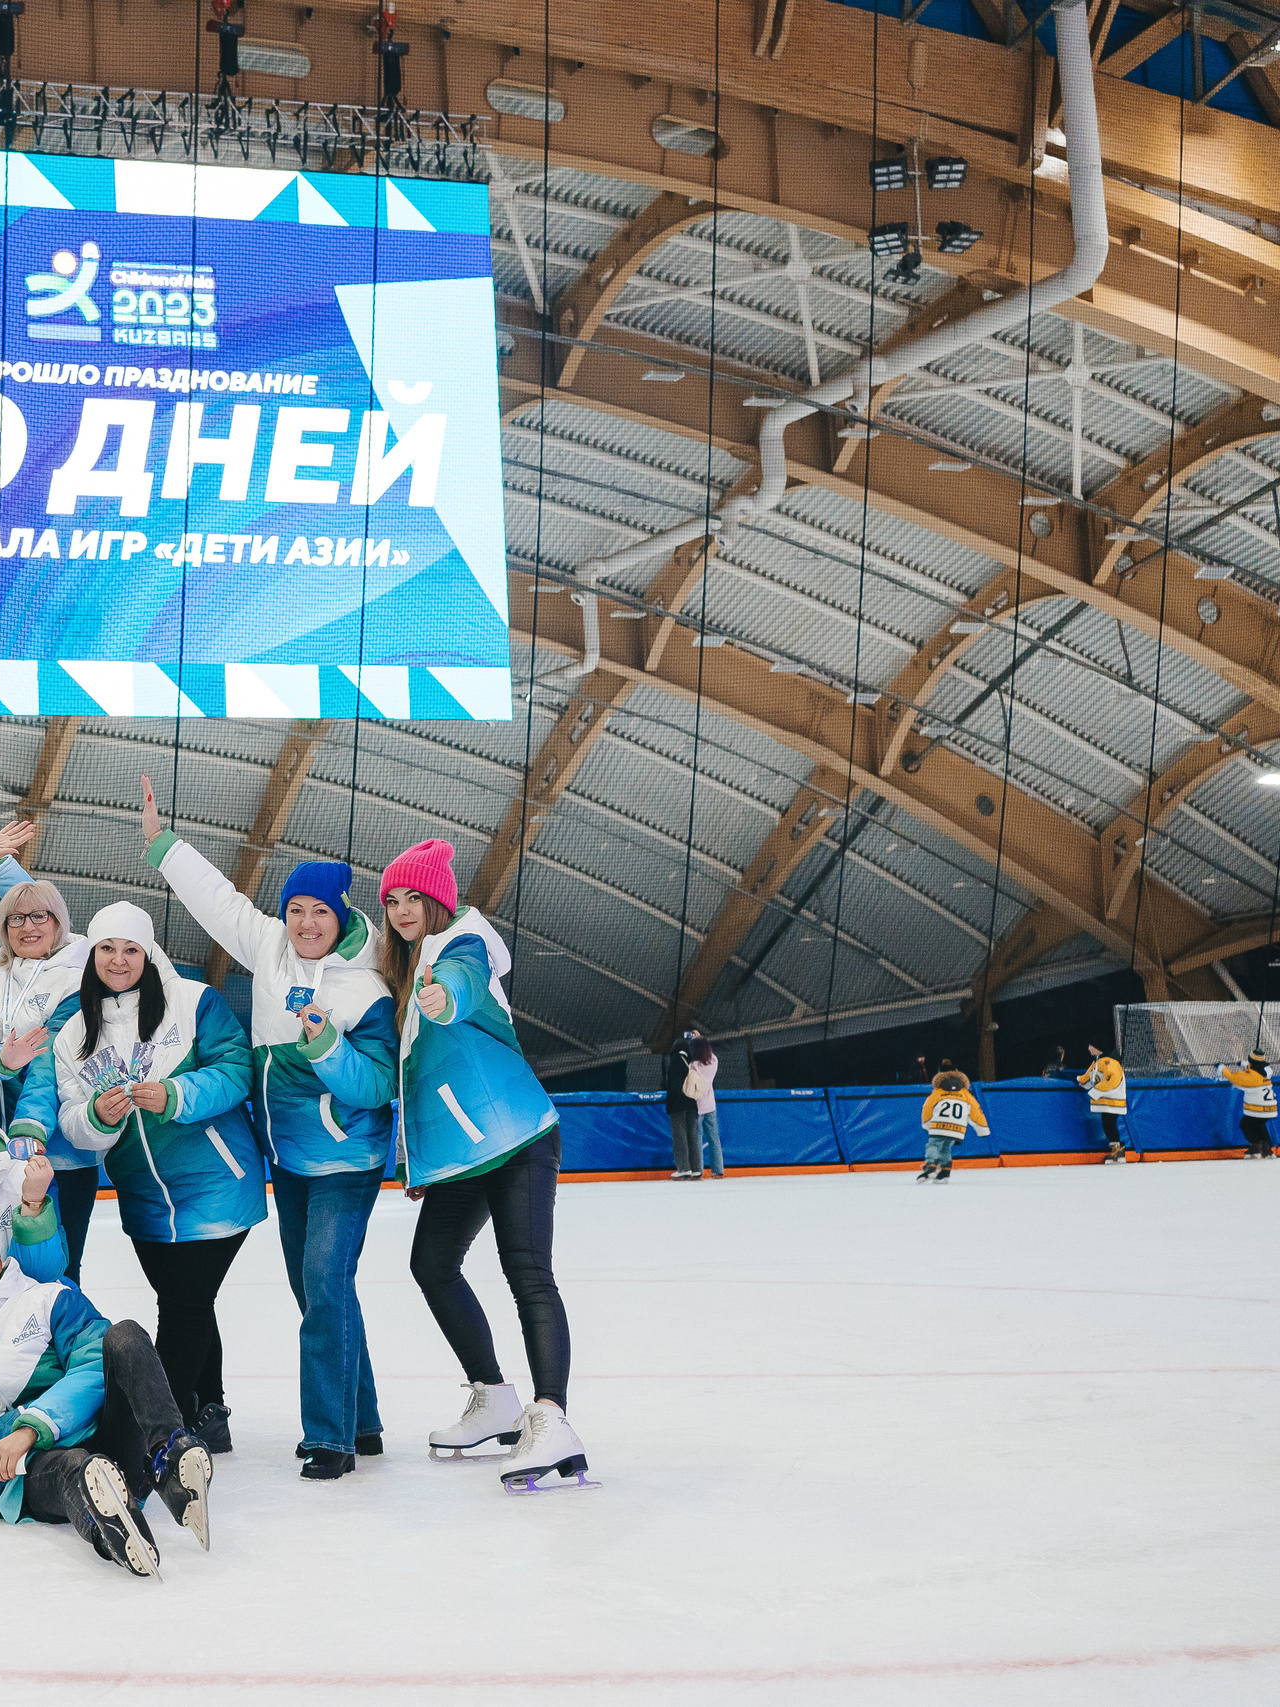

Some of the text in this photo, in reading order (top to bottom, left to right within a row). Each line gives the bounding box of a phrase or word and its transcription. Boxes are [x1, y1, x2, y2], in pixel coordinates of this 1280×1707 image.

[111, 270, 169, 287] Children
[113, 289, 216, 327] 2023
[114, 328, 217, 348] KUZBASS
[104, 366, 319, 395] ПРАЗДНОВАНИЕ
[45, 380, 447, 517] ДНЕЙ
[69, 530, 147, 562] ИГР
[153, 533, 280, 567] «ДЕТИ
[283, 536, 411, 567] АЗИИ»
[938, 1102, 963, 1119] 20
[11, 1327, 44, 1345] КУЗБАСС
